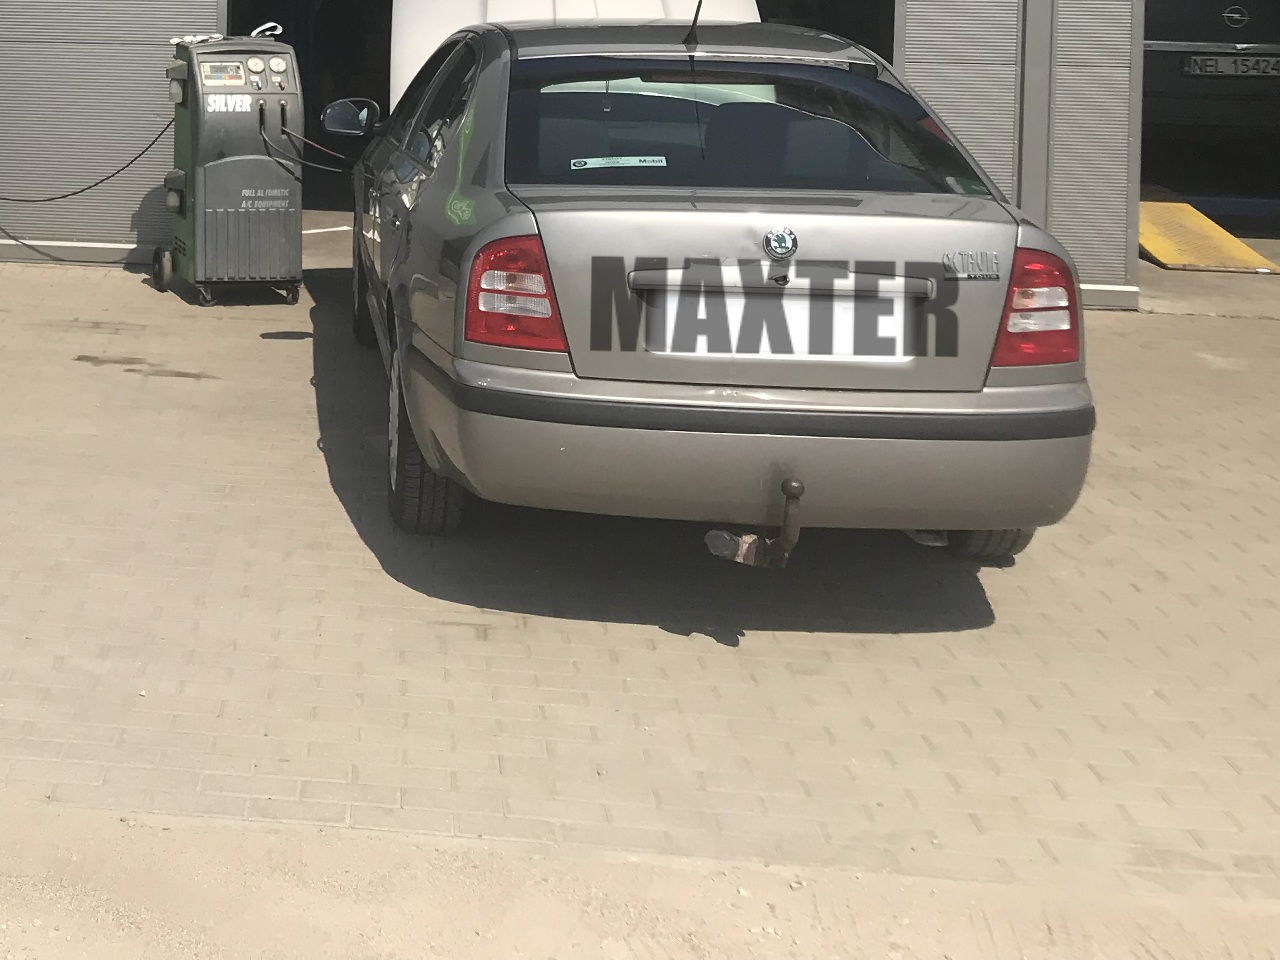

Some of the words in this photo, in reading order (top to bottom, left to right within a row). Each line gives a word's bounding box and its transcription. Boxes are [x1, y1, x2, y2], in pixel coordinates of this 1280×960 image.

[1192, 58, 1224, 74] NEL
[1231, 58, 1280, 74] 15424
[207, 94, 253, 113] SILVER
[241, 189, 256, 197] FULL
